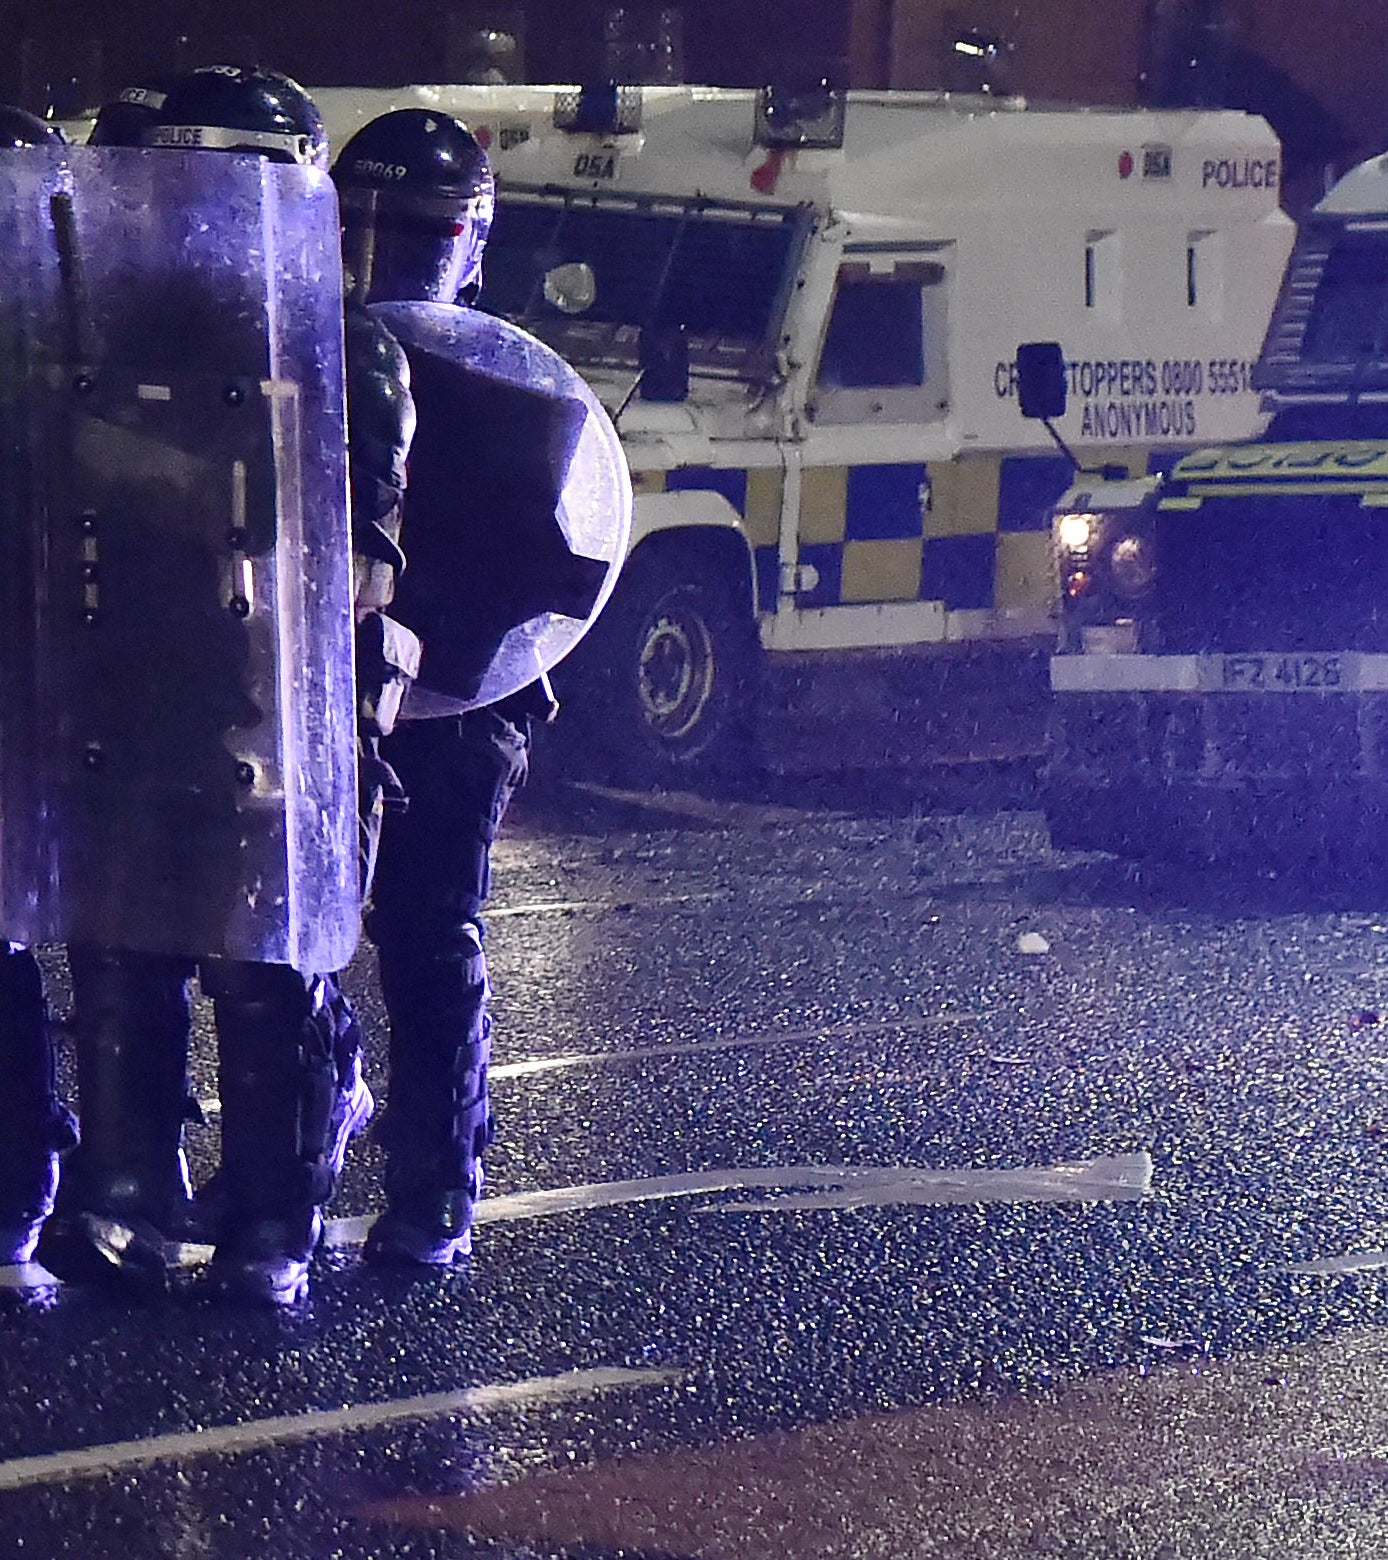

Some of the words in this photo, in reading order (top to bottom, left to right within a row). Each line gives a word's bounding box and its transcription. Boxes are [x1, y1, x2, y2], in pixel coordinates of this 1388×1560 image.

[1202, 158, 1277, 188] POLICE
[1162, 360, 1202, 395] 0800
[1081, 400, 1195, 437] ANONYMOUS
